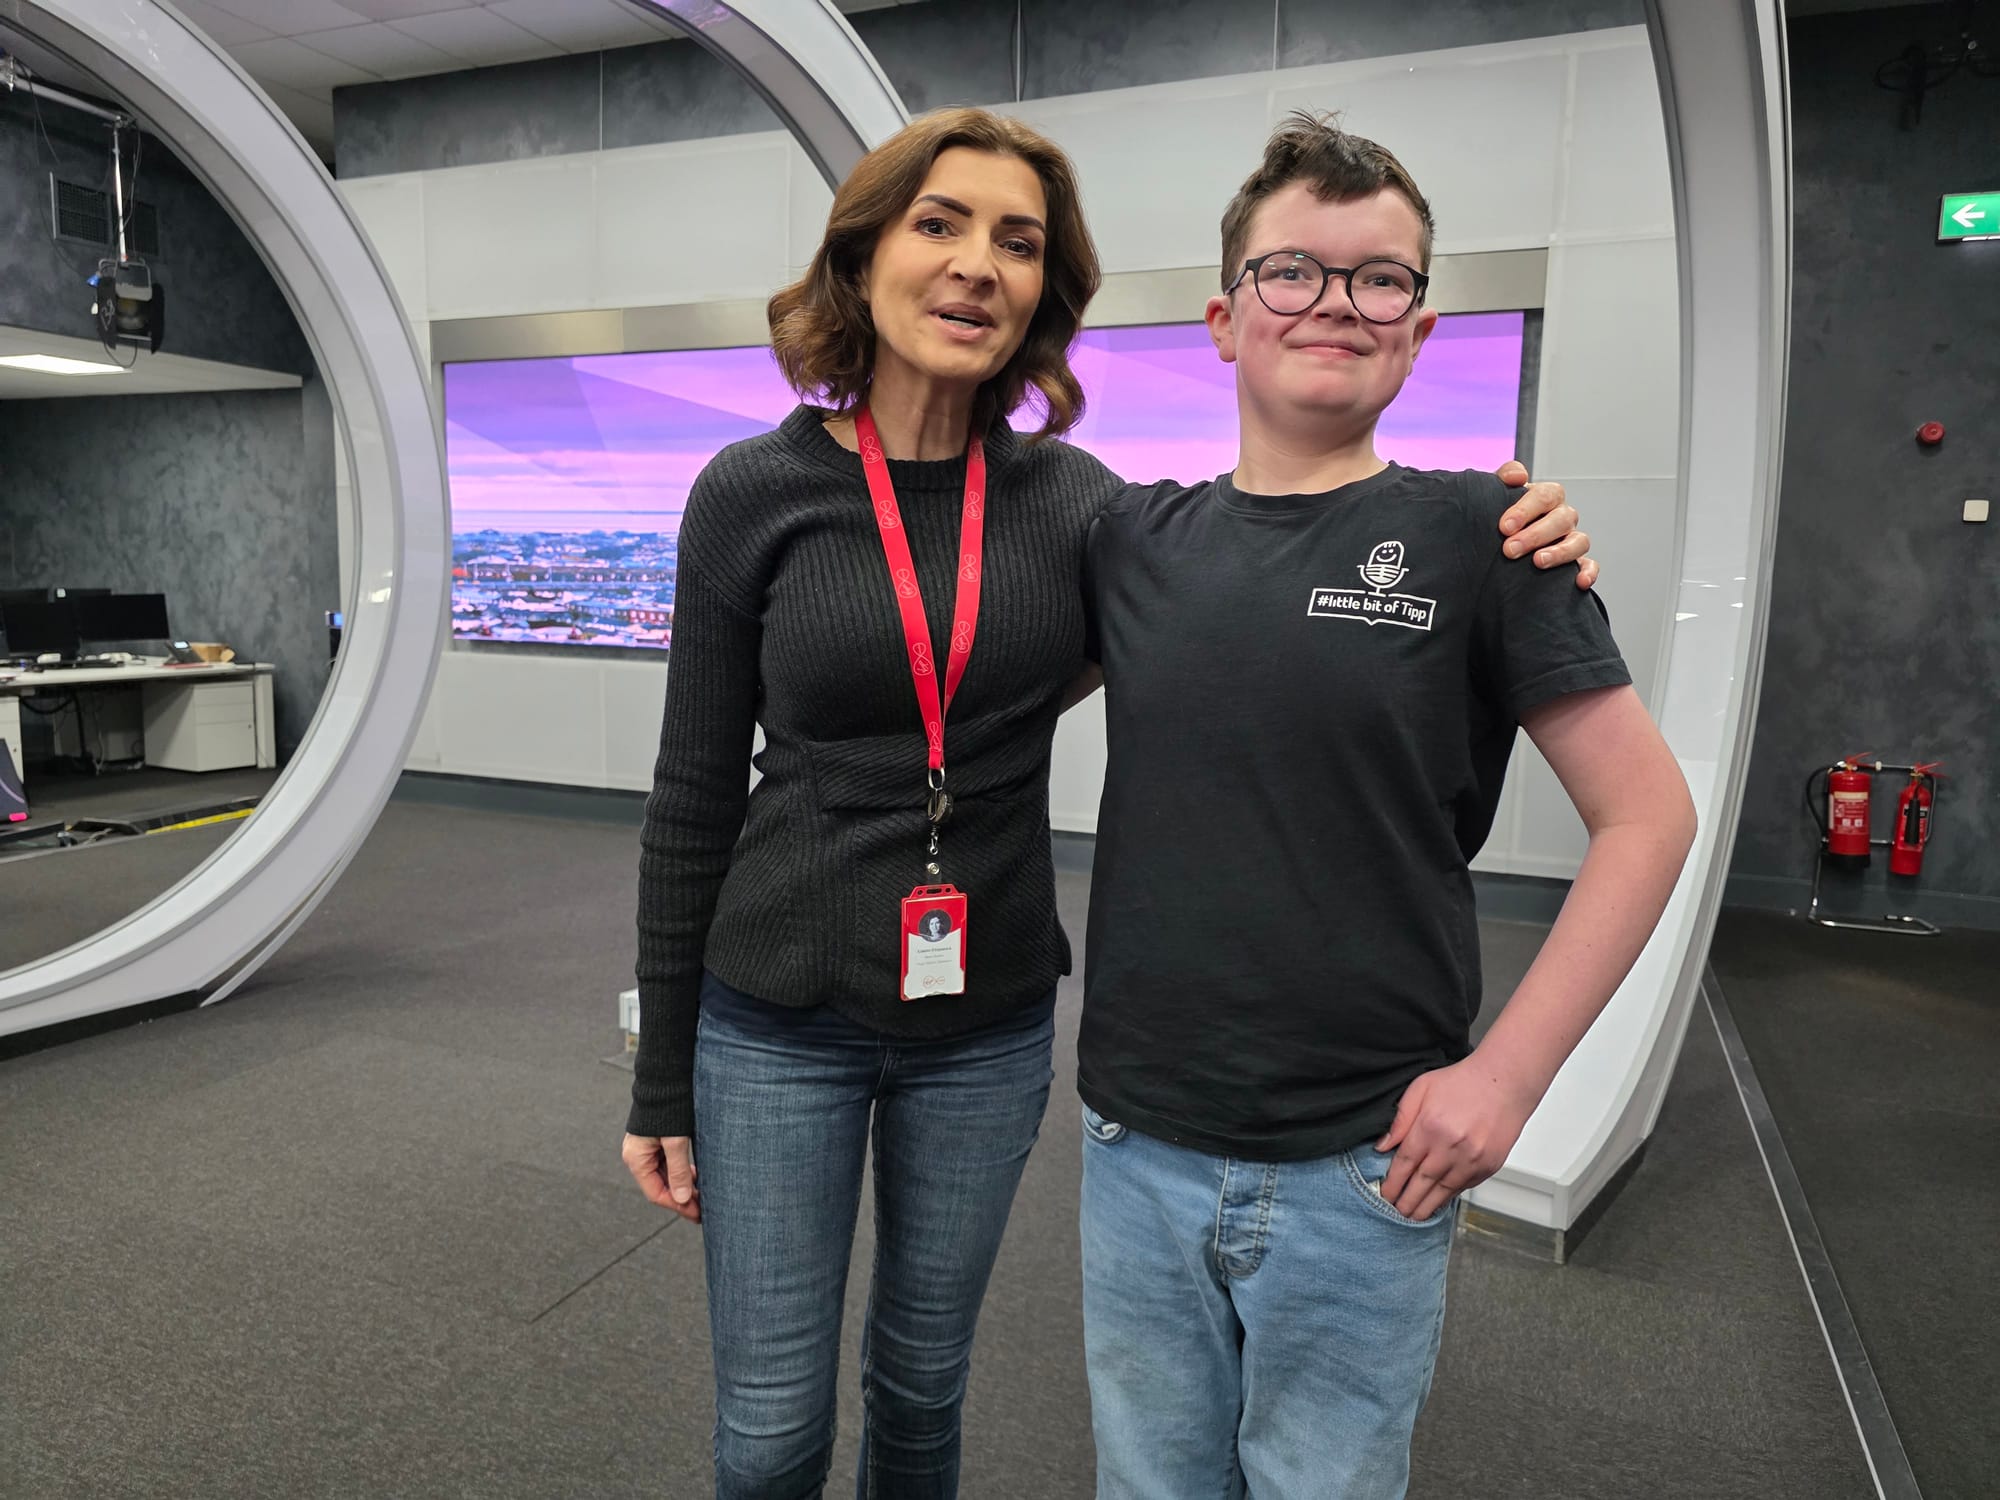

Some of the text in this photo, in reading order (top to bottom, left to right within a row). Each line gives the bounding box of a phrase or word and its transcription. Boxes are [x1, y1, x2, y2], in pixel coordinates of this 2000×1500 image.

[1363, 597, 1382, 612] bit
[1383, 600, 1400, 614] of
[1401, 601, 1427, 622] Tipp
